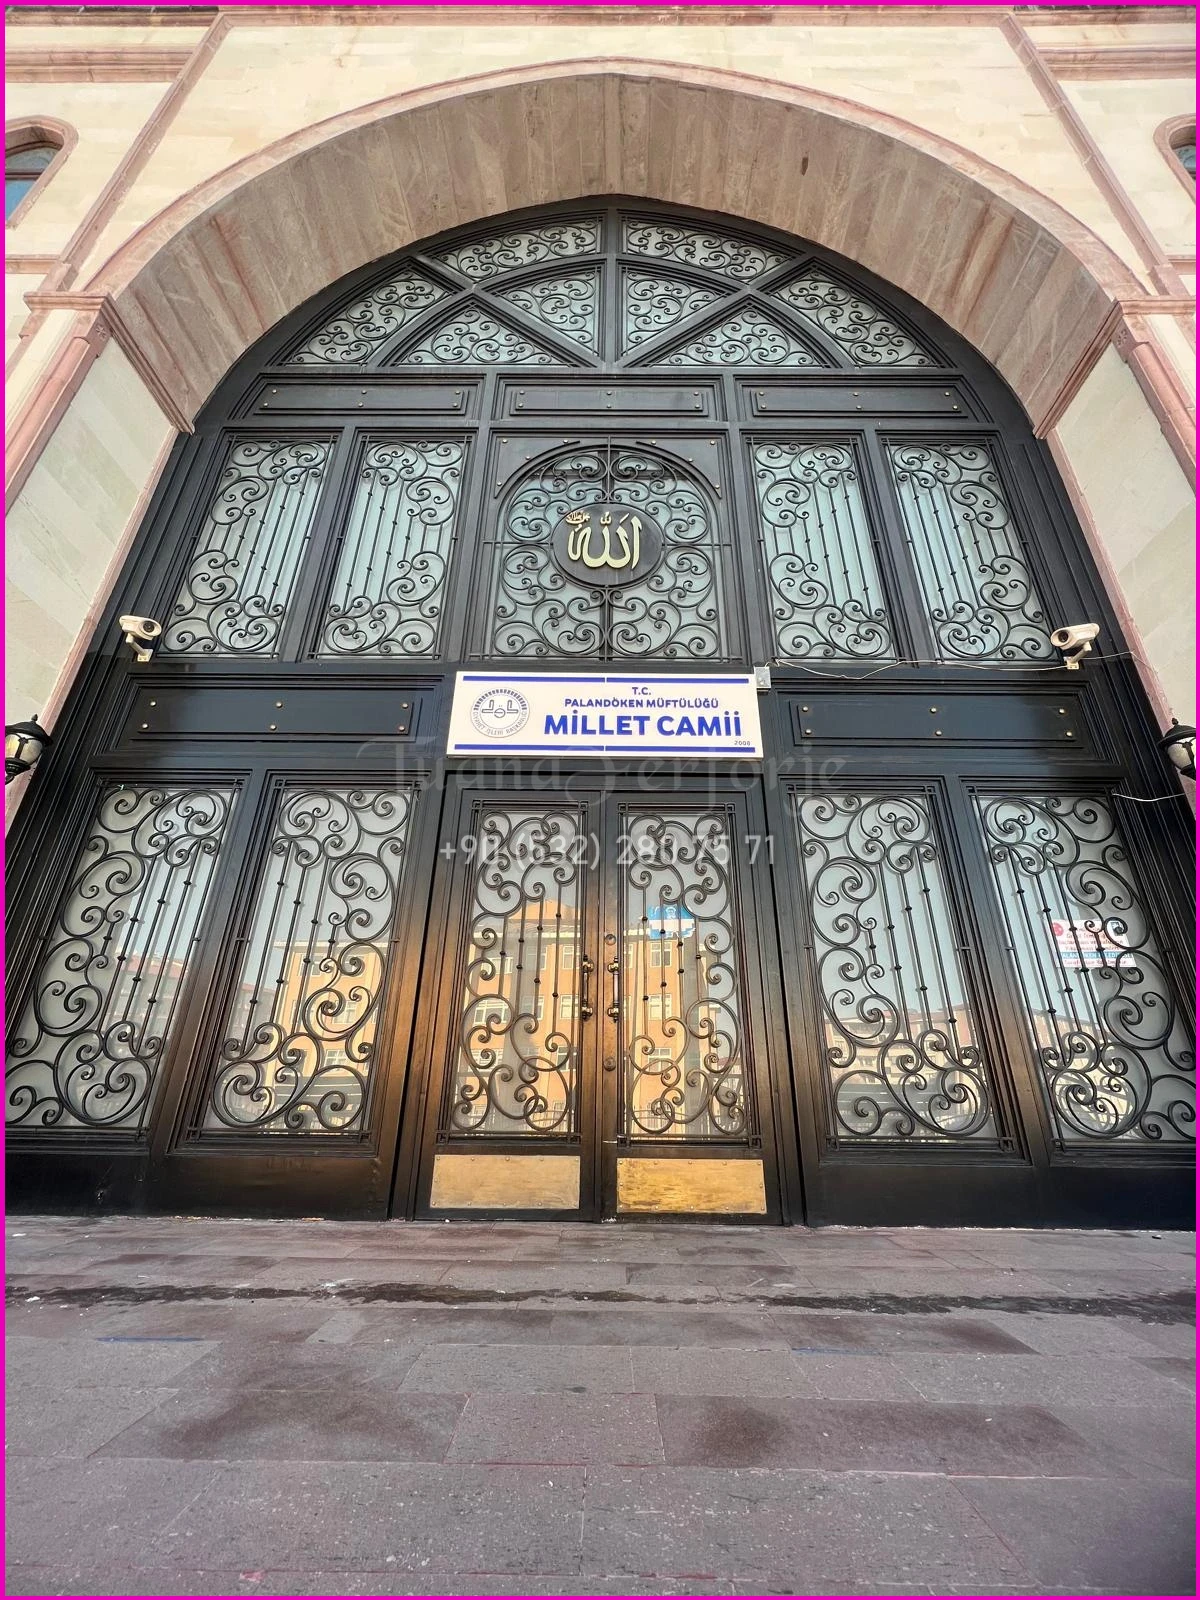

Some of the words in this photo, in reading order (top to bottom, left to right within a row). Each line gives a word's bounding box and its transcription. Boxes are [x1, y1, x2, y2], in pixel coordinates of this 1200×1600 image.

[631, 686, 652, 696] T.C.
[564, 696, 644, 708] PALANDÖKEN
[646, 697, 719, 709] MÜFTÜLÜĞÜ
[543, 709, 651, 736] MİLLET
[656, 710, 742, 737] CAMİİ
